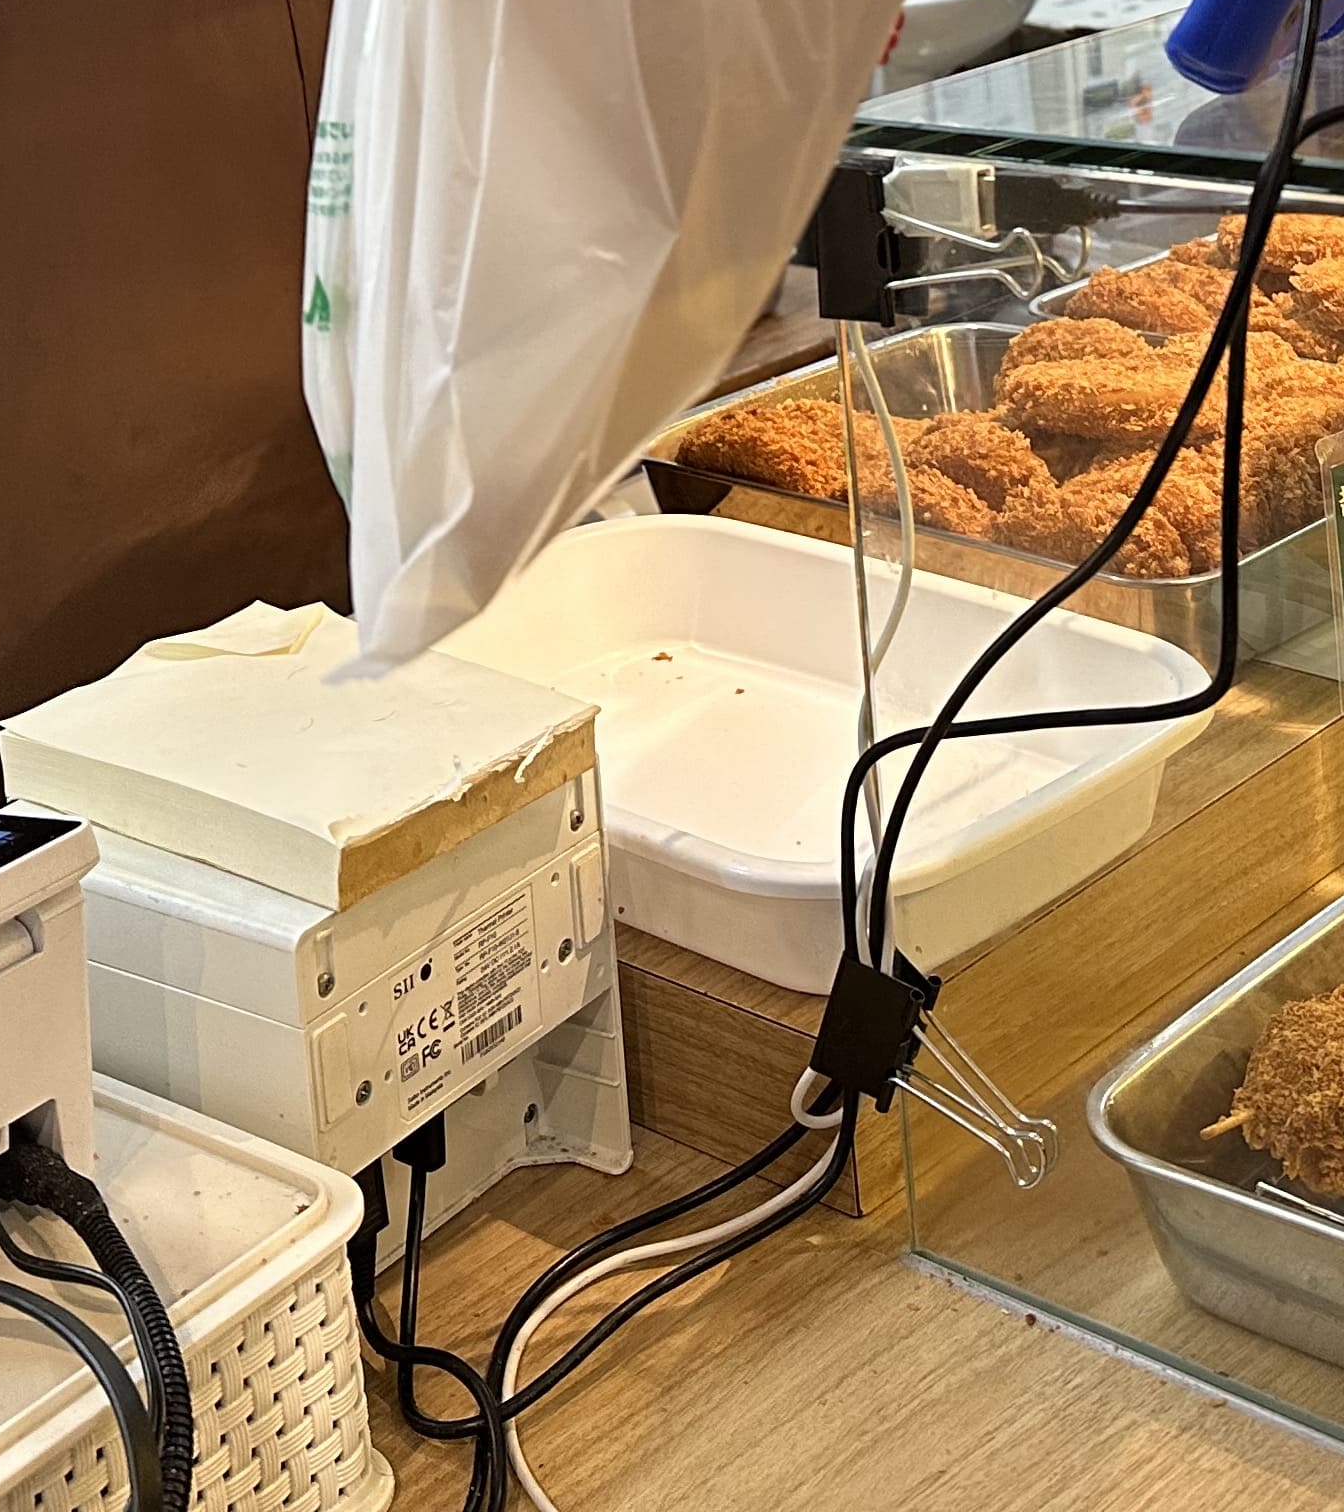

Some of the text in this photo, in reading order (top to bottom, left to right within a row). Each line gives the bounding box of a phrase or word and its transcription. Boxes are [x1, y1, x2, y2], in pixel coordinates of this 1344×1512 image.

[393, 974, 415, 1001] SII
[398, 1024, 413, 1043] UK
[399, 1038, 416, 1056] CA
